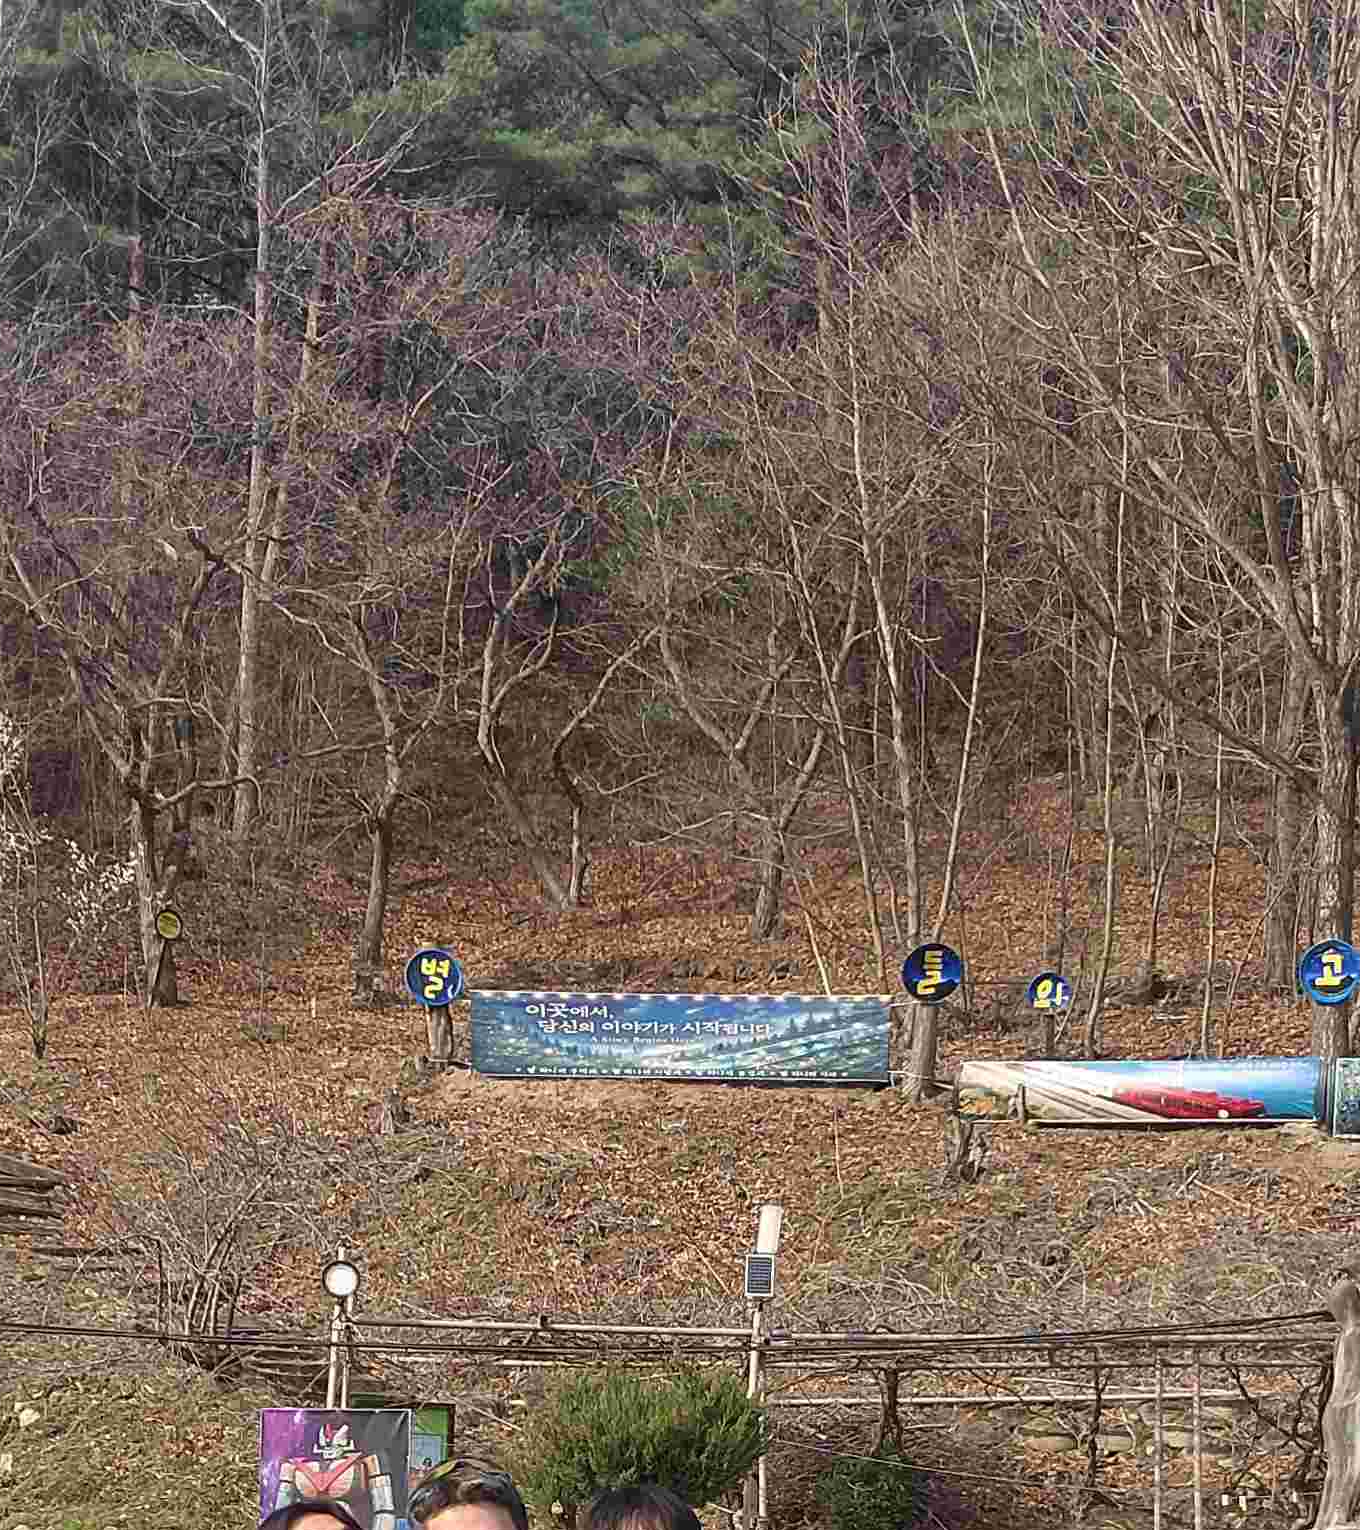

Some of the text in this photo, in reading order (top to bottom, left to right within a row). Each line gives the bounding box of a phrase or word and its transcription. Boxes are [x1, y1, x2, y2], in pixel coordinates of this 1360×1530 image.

[421, 959, 449, 999] 별
[1314, 949, 1347, 988] 고
[525, 1002, 615, 1020] 이곳에서,
[538, 1020, 595, 1035] 당신의
[601, 1020, 676, 1035] 이야기가
